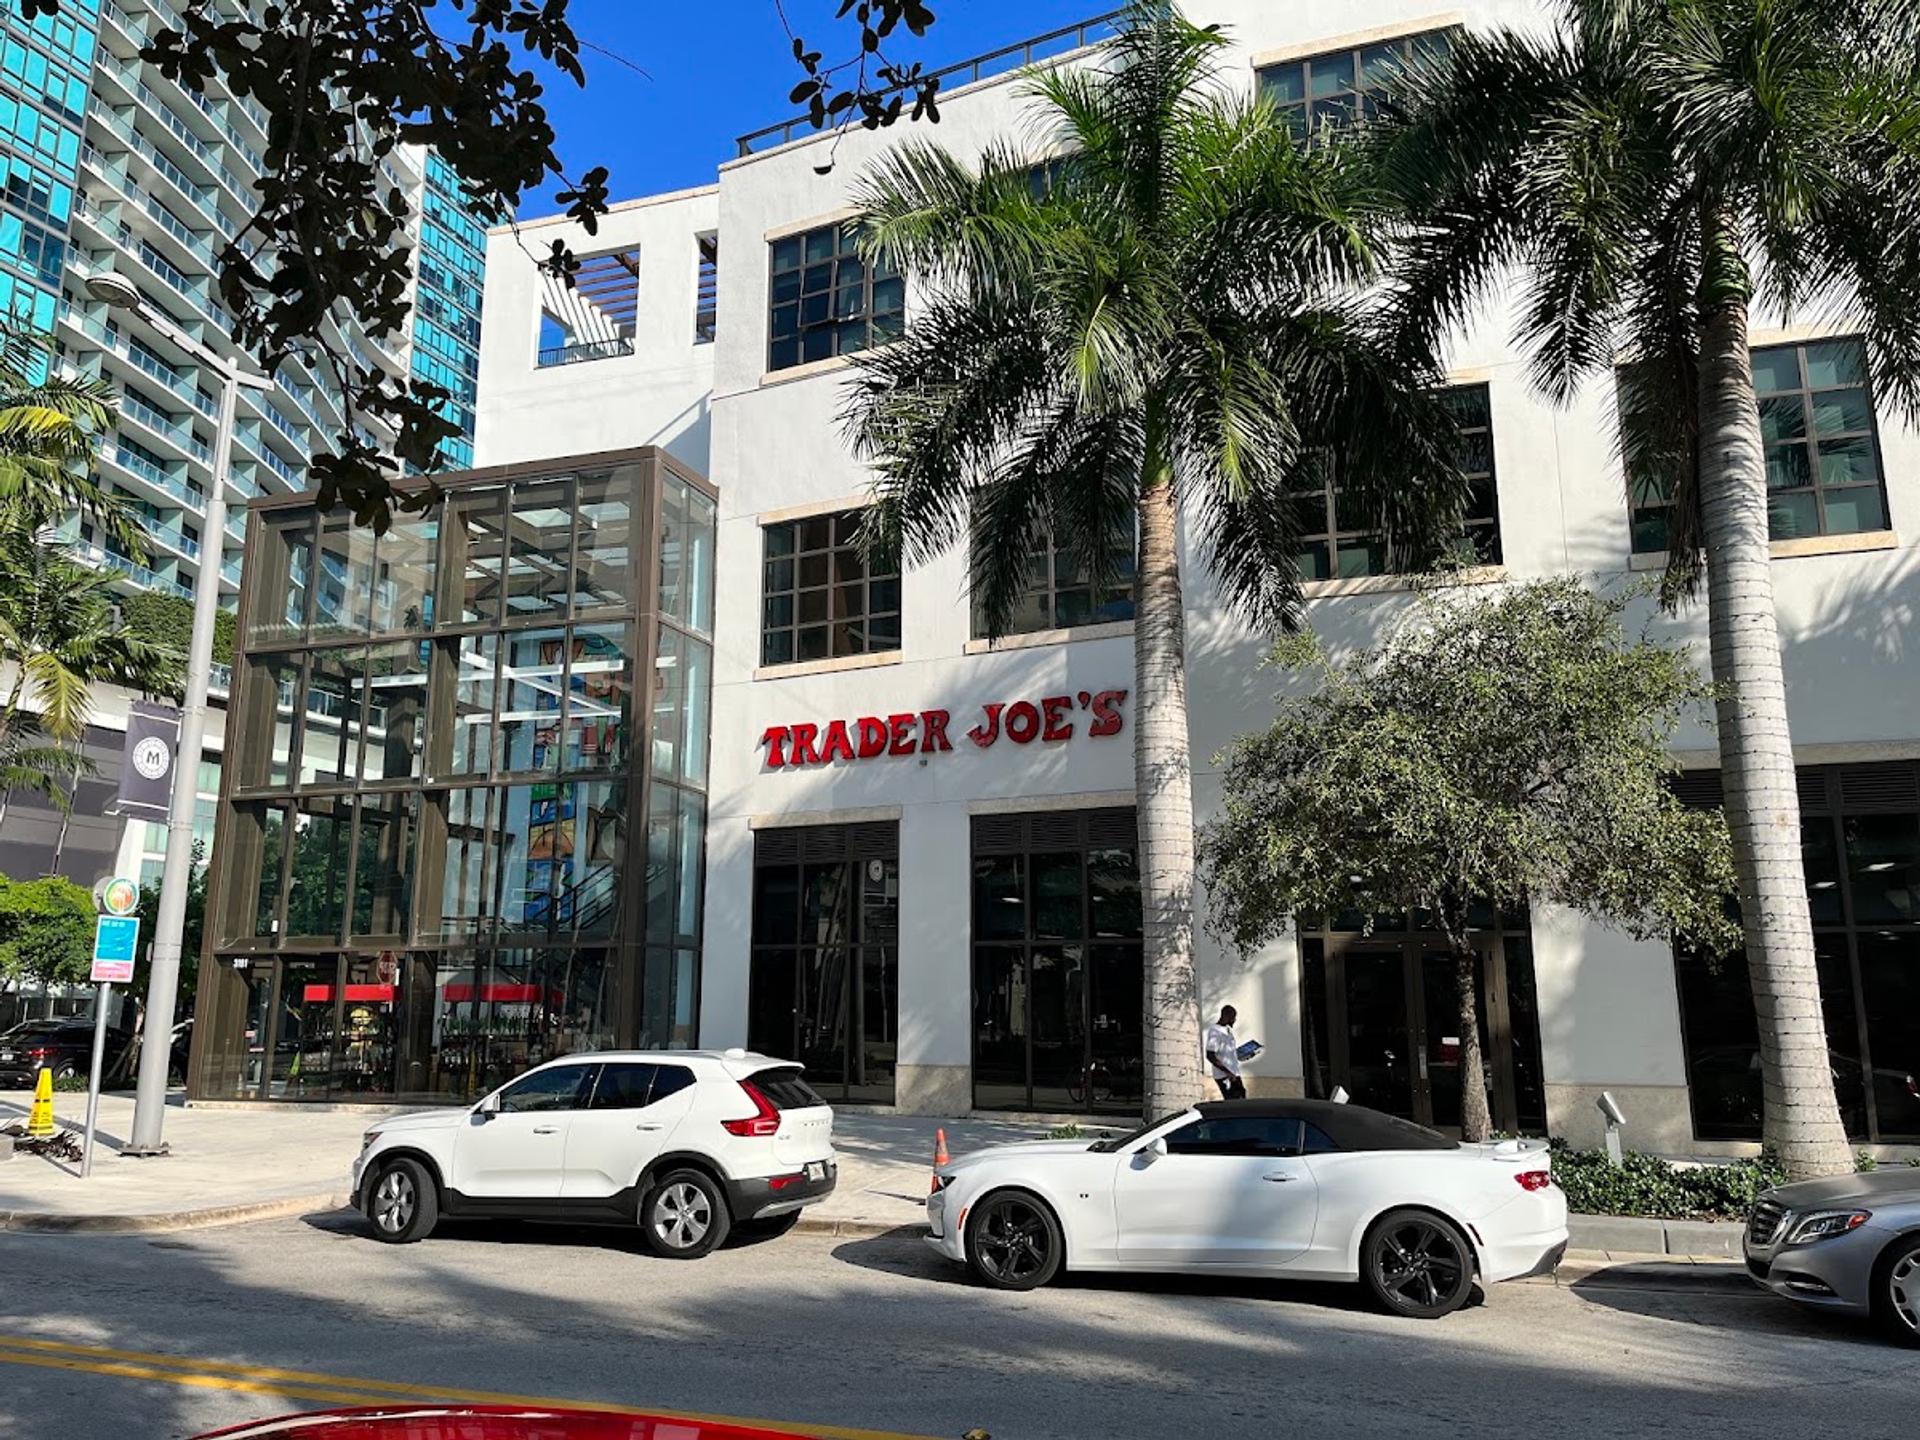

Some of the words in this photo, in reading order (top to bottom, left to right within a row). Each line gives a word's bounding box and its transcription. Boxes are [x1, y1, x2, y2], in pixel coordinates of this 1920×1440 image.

[762, 709, 954, 768] TRADER
[966, 689, 1129, 749] JOE'S
[146, 750, 160, 766] M
